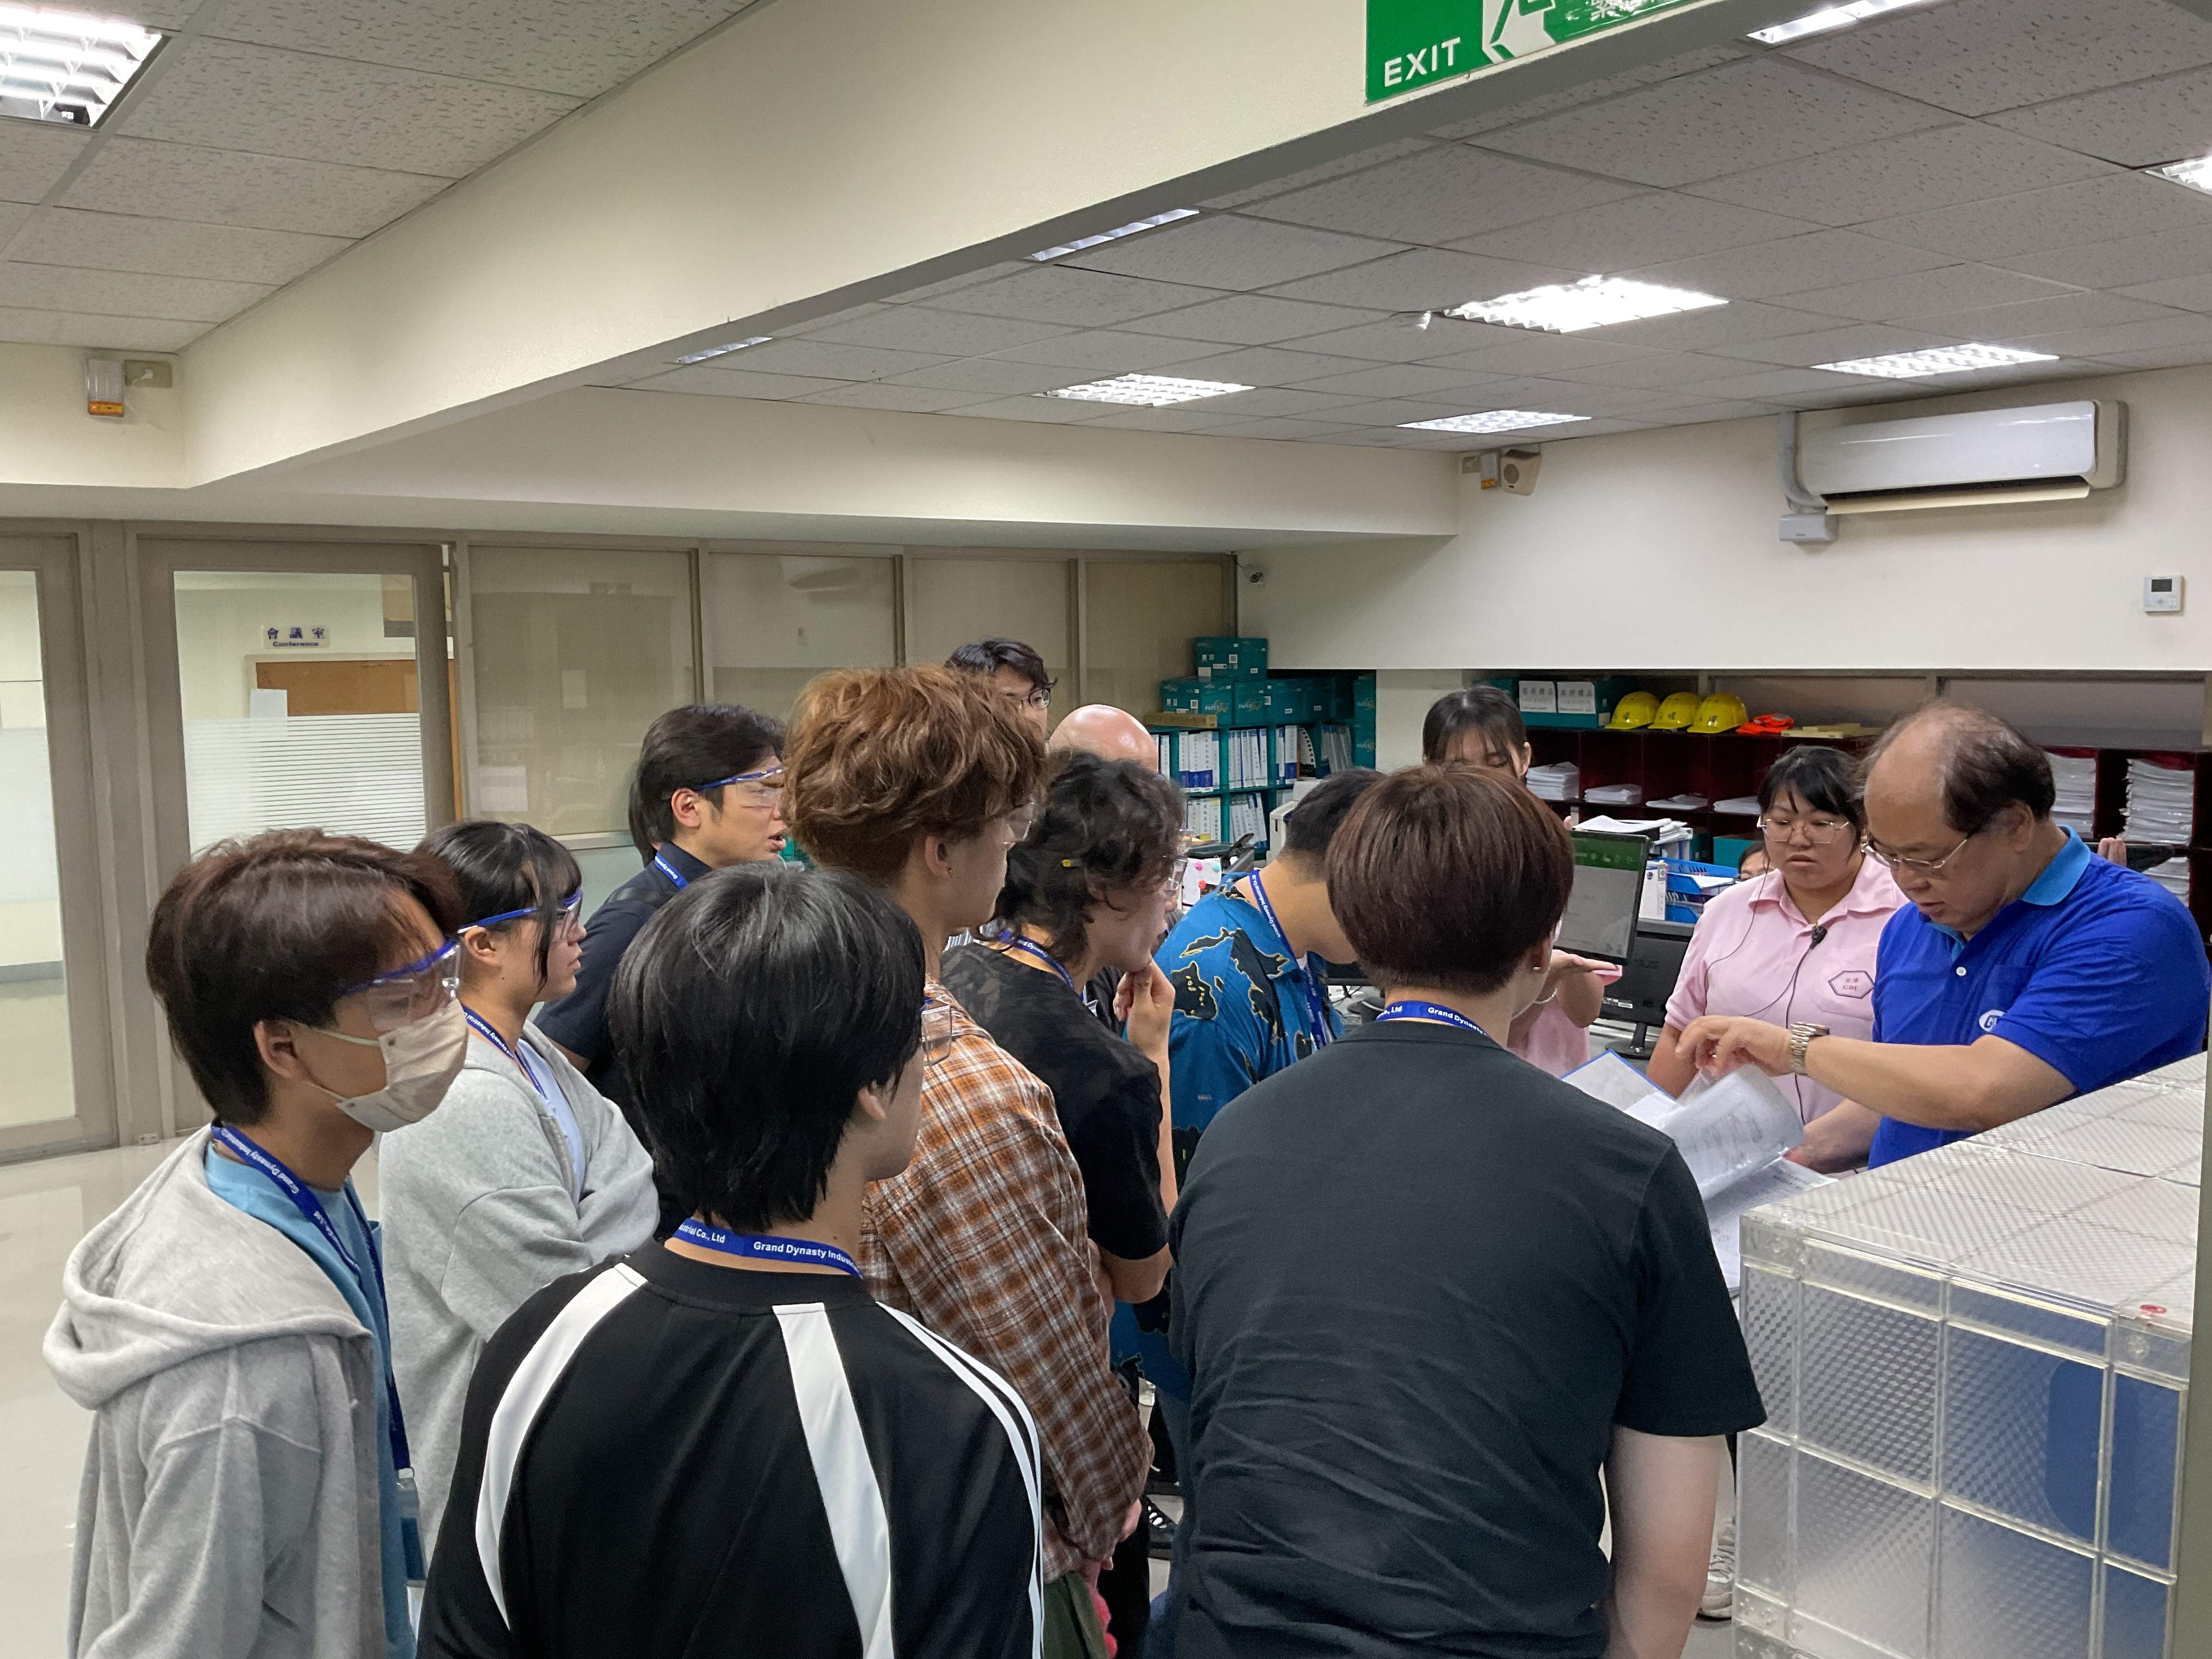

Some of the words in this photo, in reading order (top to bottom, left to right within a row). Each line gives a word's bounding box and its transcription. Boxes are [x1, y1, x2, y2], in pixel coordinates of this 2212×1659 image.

[1384, 37, 1460, 87] EXIT
[1427, 1007, 1453, 1019] Grand
[466, 1015, 490, 1035] Industrial
[250, 1151, 279, 1176] Dynasty
[277, 1172, 300, 1194] Grand
[712, 1232, 725, 1243] Ltd
[753, 1241, 784, 1253] Grand
[786, 1244, 827, 1258] Dynasty
